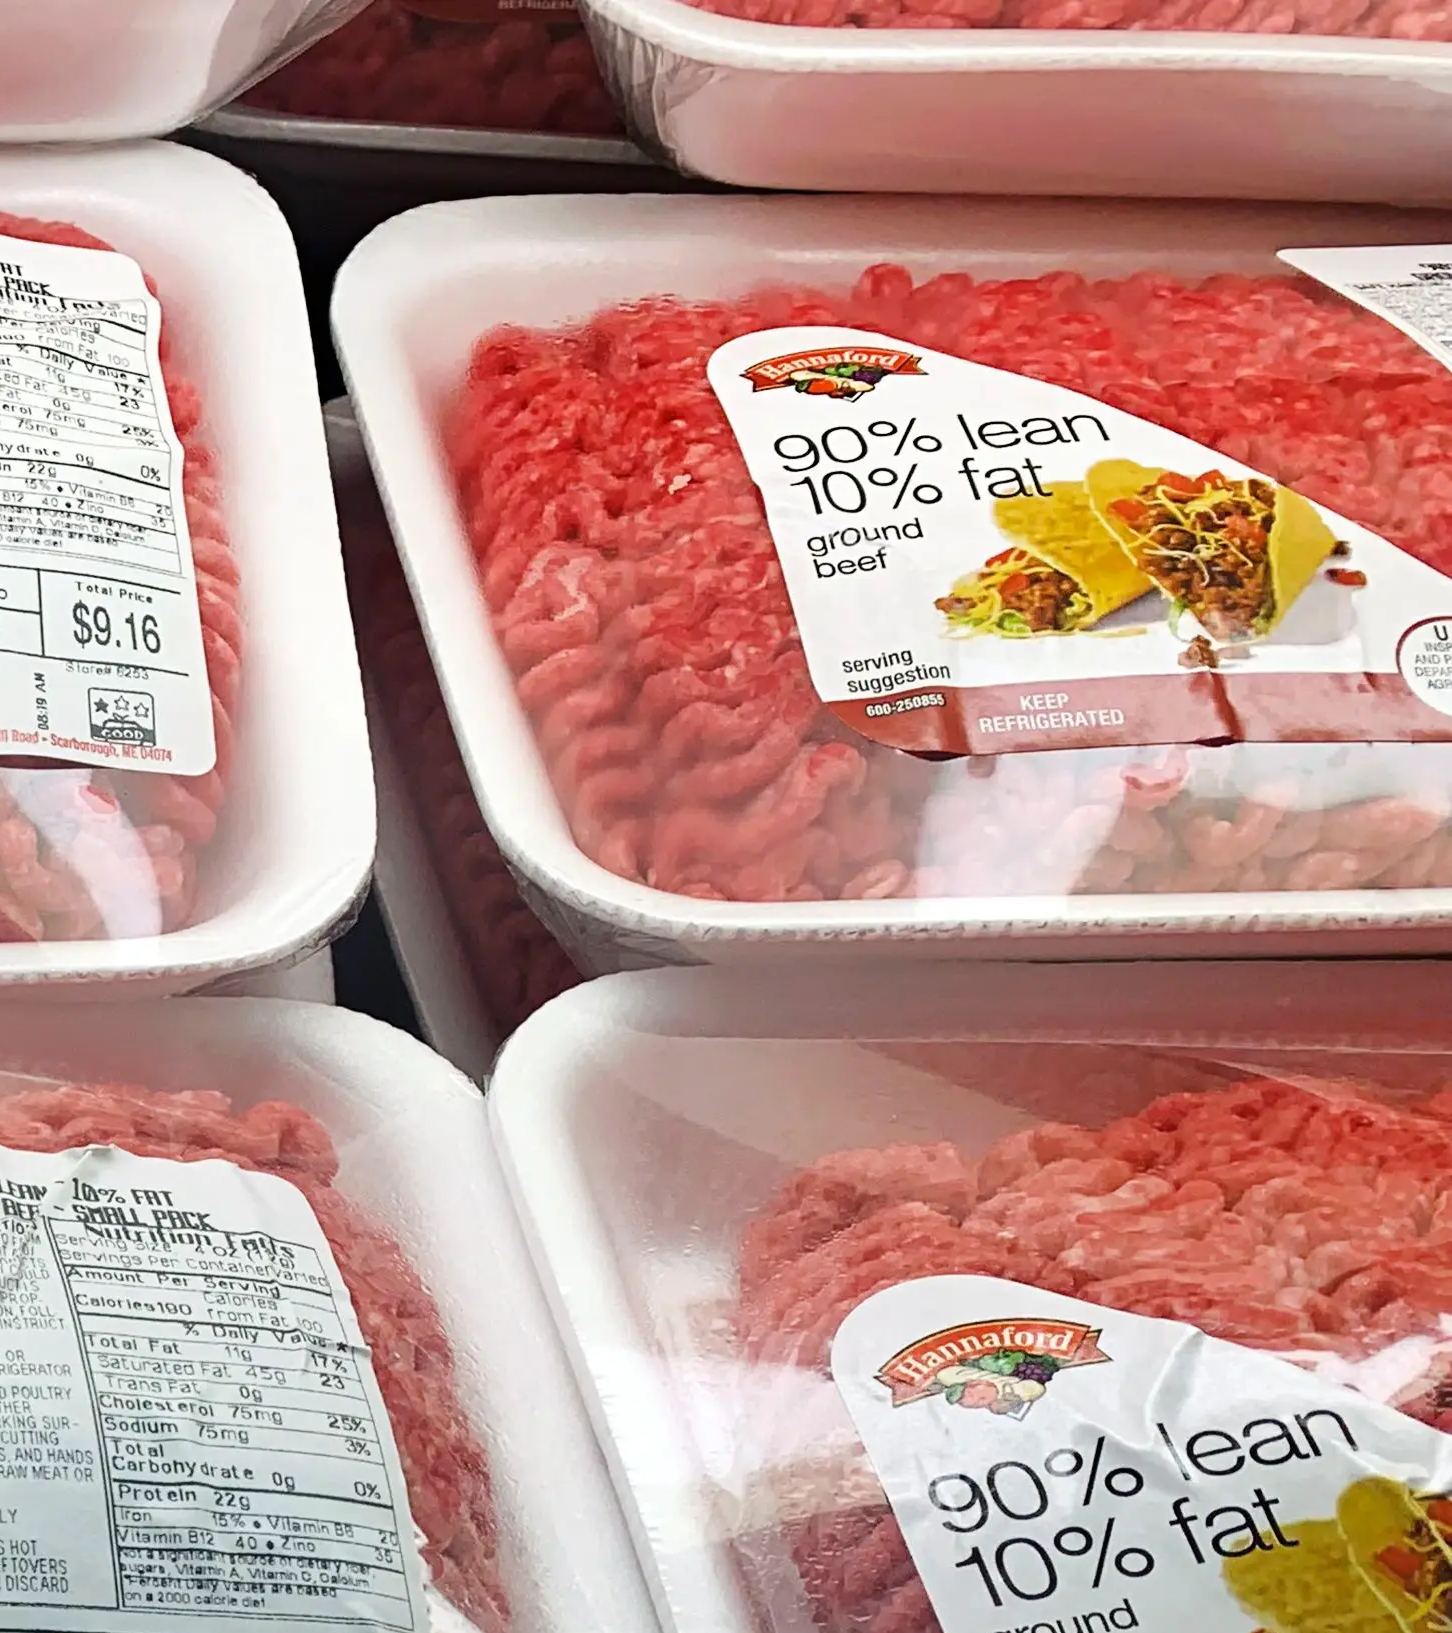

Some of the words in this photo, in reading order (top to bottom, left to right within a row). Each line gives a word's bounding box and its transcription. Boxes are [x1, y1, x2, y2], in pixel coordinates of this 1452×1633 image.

[757, 349, 900, 380] Hannaford
[774, 417, 942, 474] 90%
[957, 411, 1111, 450] lean
[791, 463, 943, 517] 10%
[957, 455, 1055, 505] fat
[807, 517, 925, 559] ground
[814, 547, 889, 580] beef
[72, 600, 162, 654] $9.16
[842, 647, 913, 675] serving
[845, 662, 952, 695] suggestion
[979, 707, 1125, 733] REFRIGERATED
[1019, 692, 1069, 712] KEEP
[897, 1321, 1075, 1384] Hannaford
[98, 1395, 215, 1419] Cholesterol
[228, 1403, 284, 1426] 75mg
[327, 1415, 367, 1434] 25%
[928, 1436, 1145, 1534] 90%
[1156, 1409, 1360, 1482] lean
[118, 1484, 199, 1504] Protein
[954, 1517, 1156, 1608] 10%
[1170, 1488, 1299, 1565] fat
